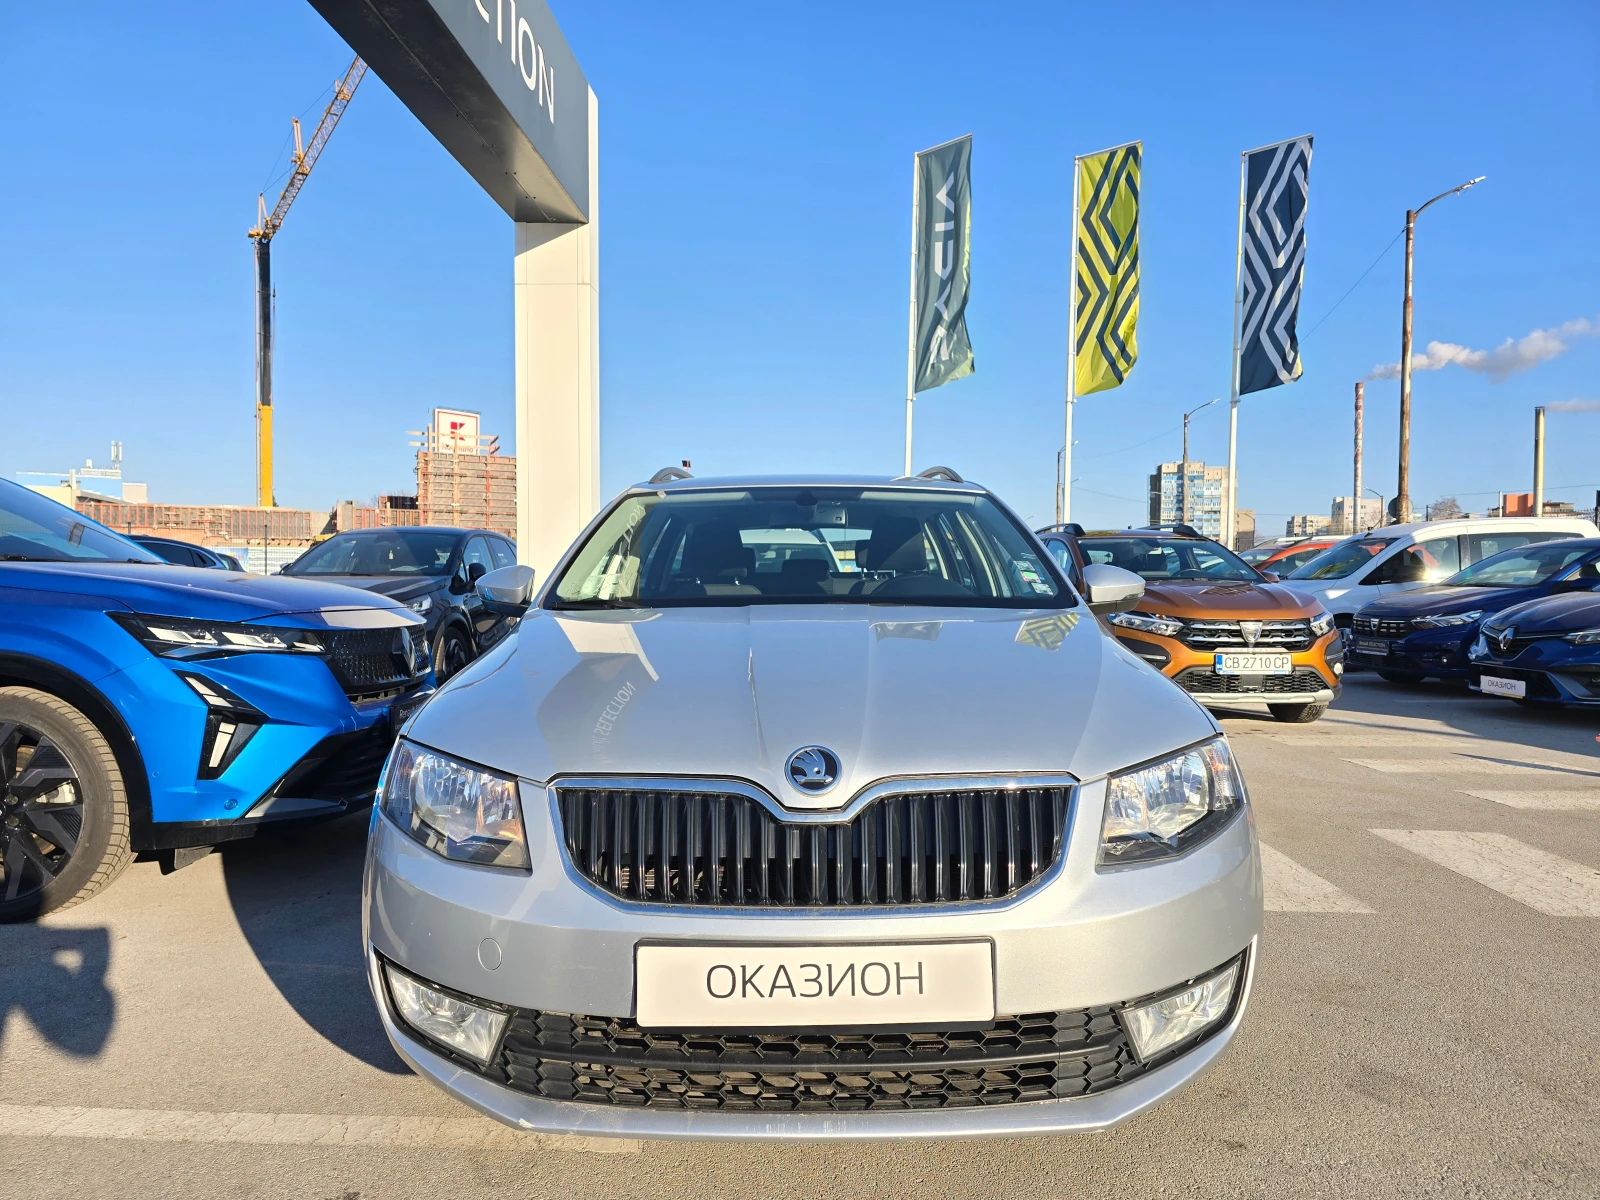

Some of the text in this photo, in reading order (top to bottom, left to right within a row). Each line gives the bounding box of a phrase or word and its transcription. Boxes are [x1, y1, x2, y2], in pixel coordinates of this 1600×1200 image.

[1224, 656, 1290, 669] CB 2710 CP
[1487, 679, 1516, 691] ОКАЗИОН
[706, 961, 924, 999] ОКАЗИОН
